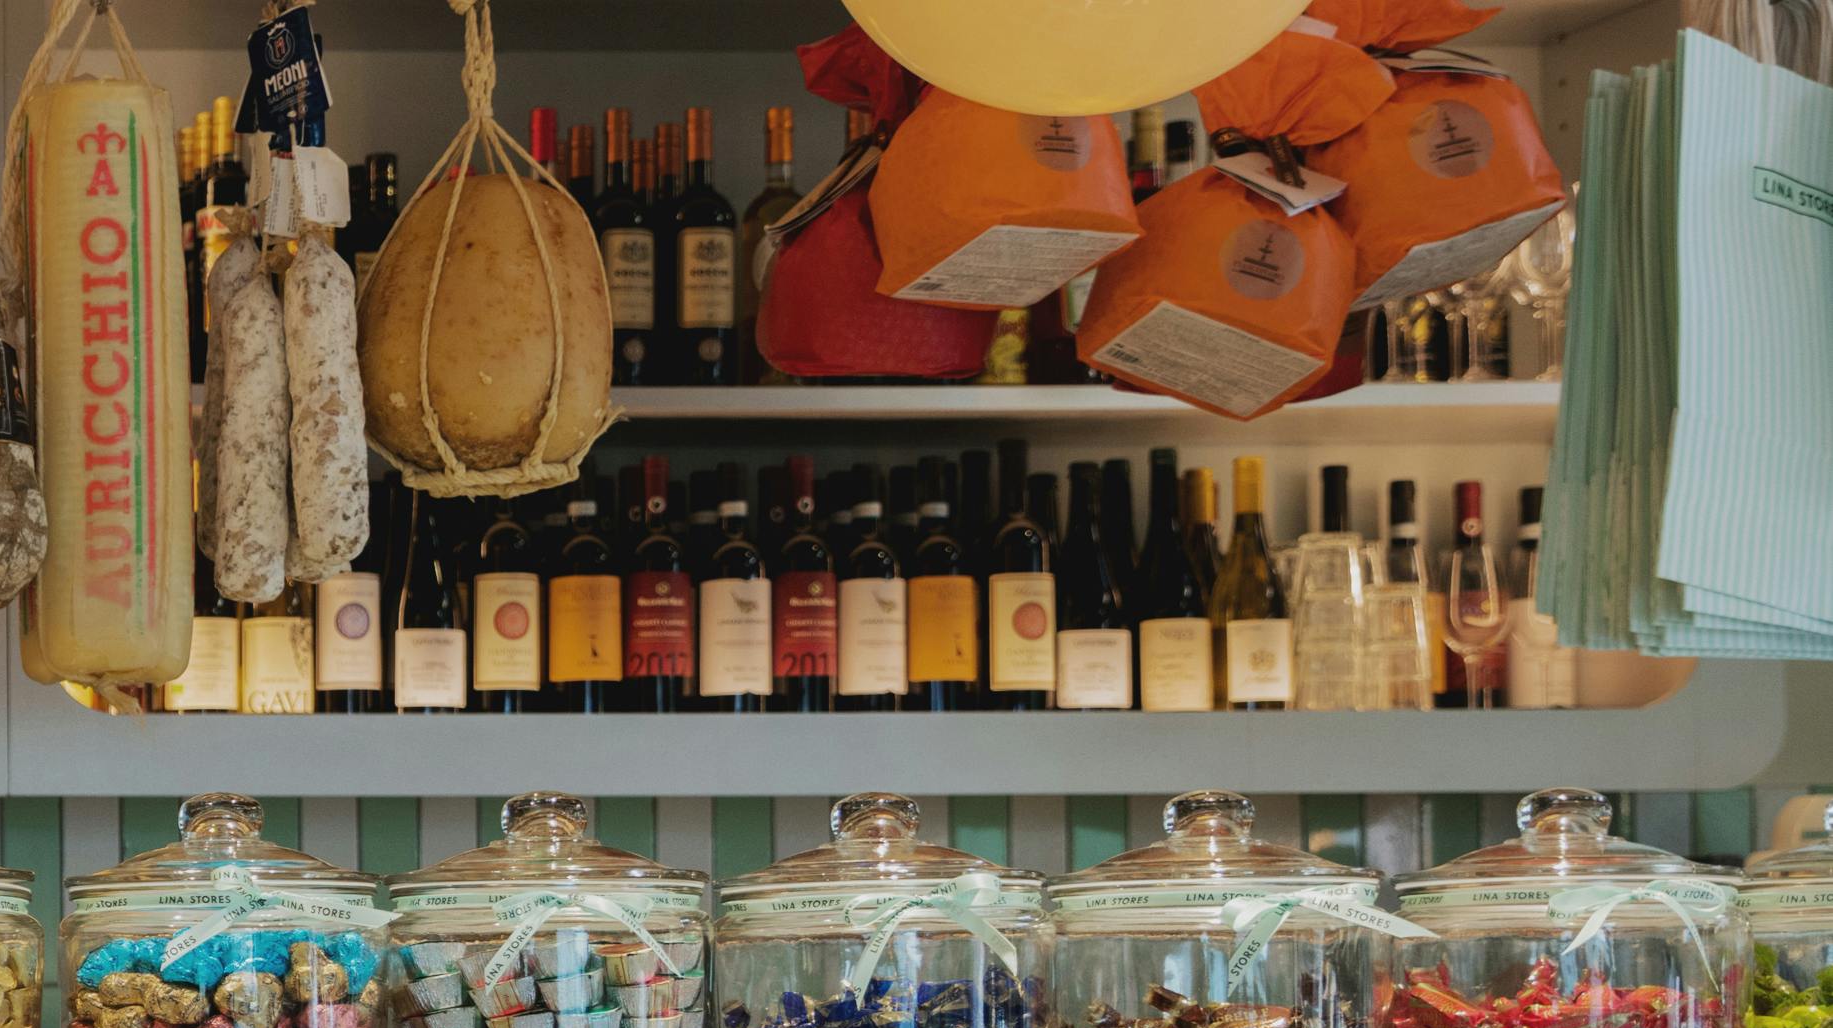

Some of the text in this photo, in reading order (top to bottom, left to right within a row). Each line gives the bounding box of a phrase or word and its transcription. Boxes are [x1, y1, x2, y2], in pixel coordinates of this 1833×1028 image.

[264, 59, 307, 96] MEONI
[1762, 177, 1792, 200] LINA
[79, 215, 133, 612] AURICCHIO
[159, 895, 231, 905] LINA STORES
[772, 898, 841, 911] LINA STORES
[1085, 895, 1150, 908] LINA STORES
[1472, 891, 1550, 901] LINA STORES
[281, 900, 352, 921] LINA STORES
[1311, 896, 1391, 931] LINA STORES
[485, 923, 533, 986] LINA STORES
